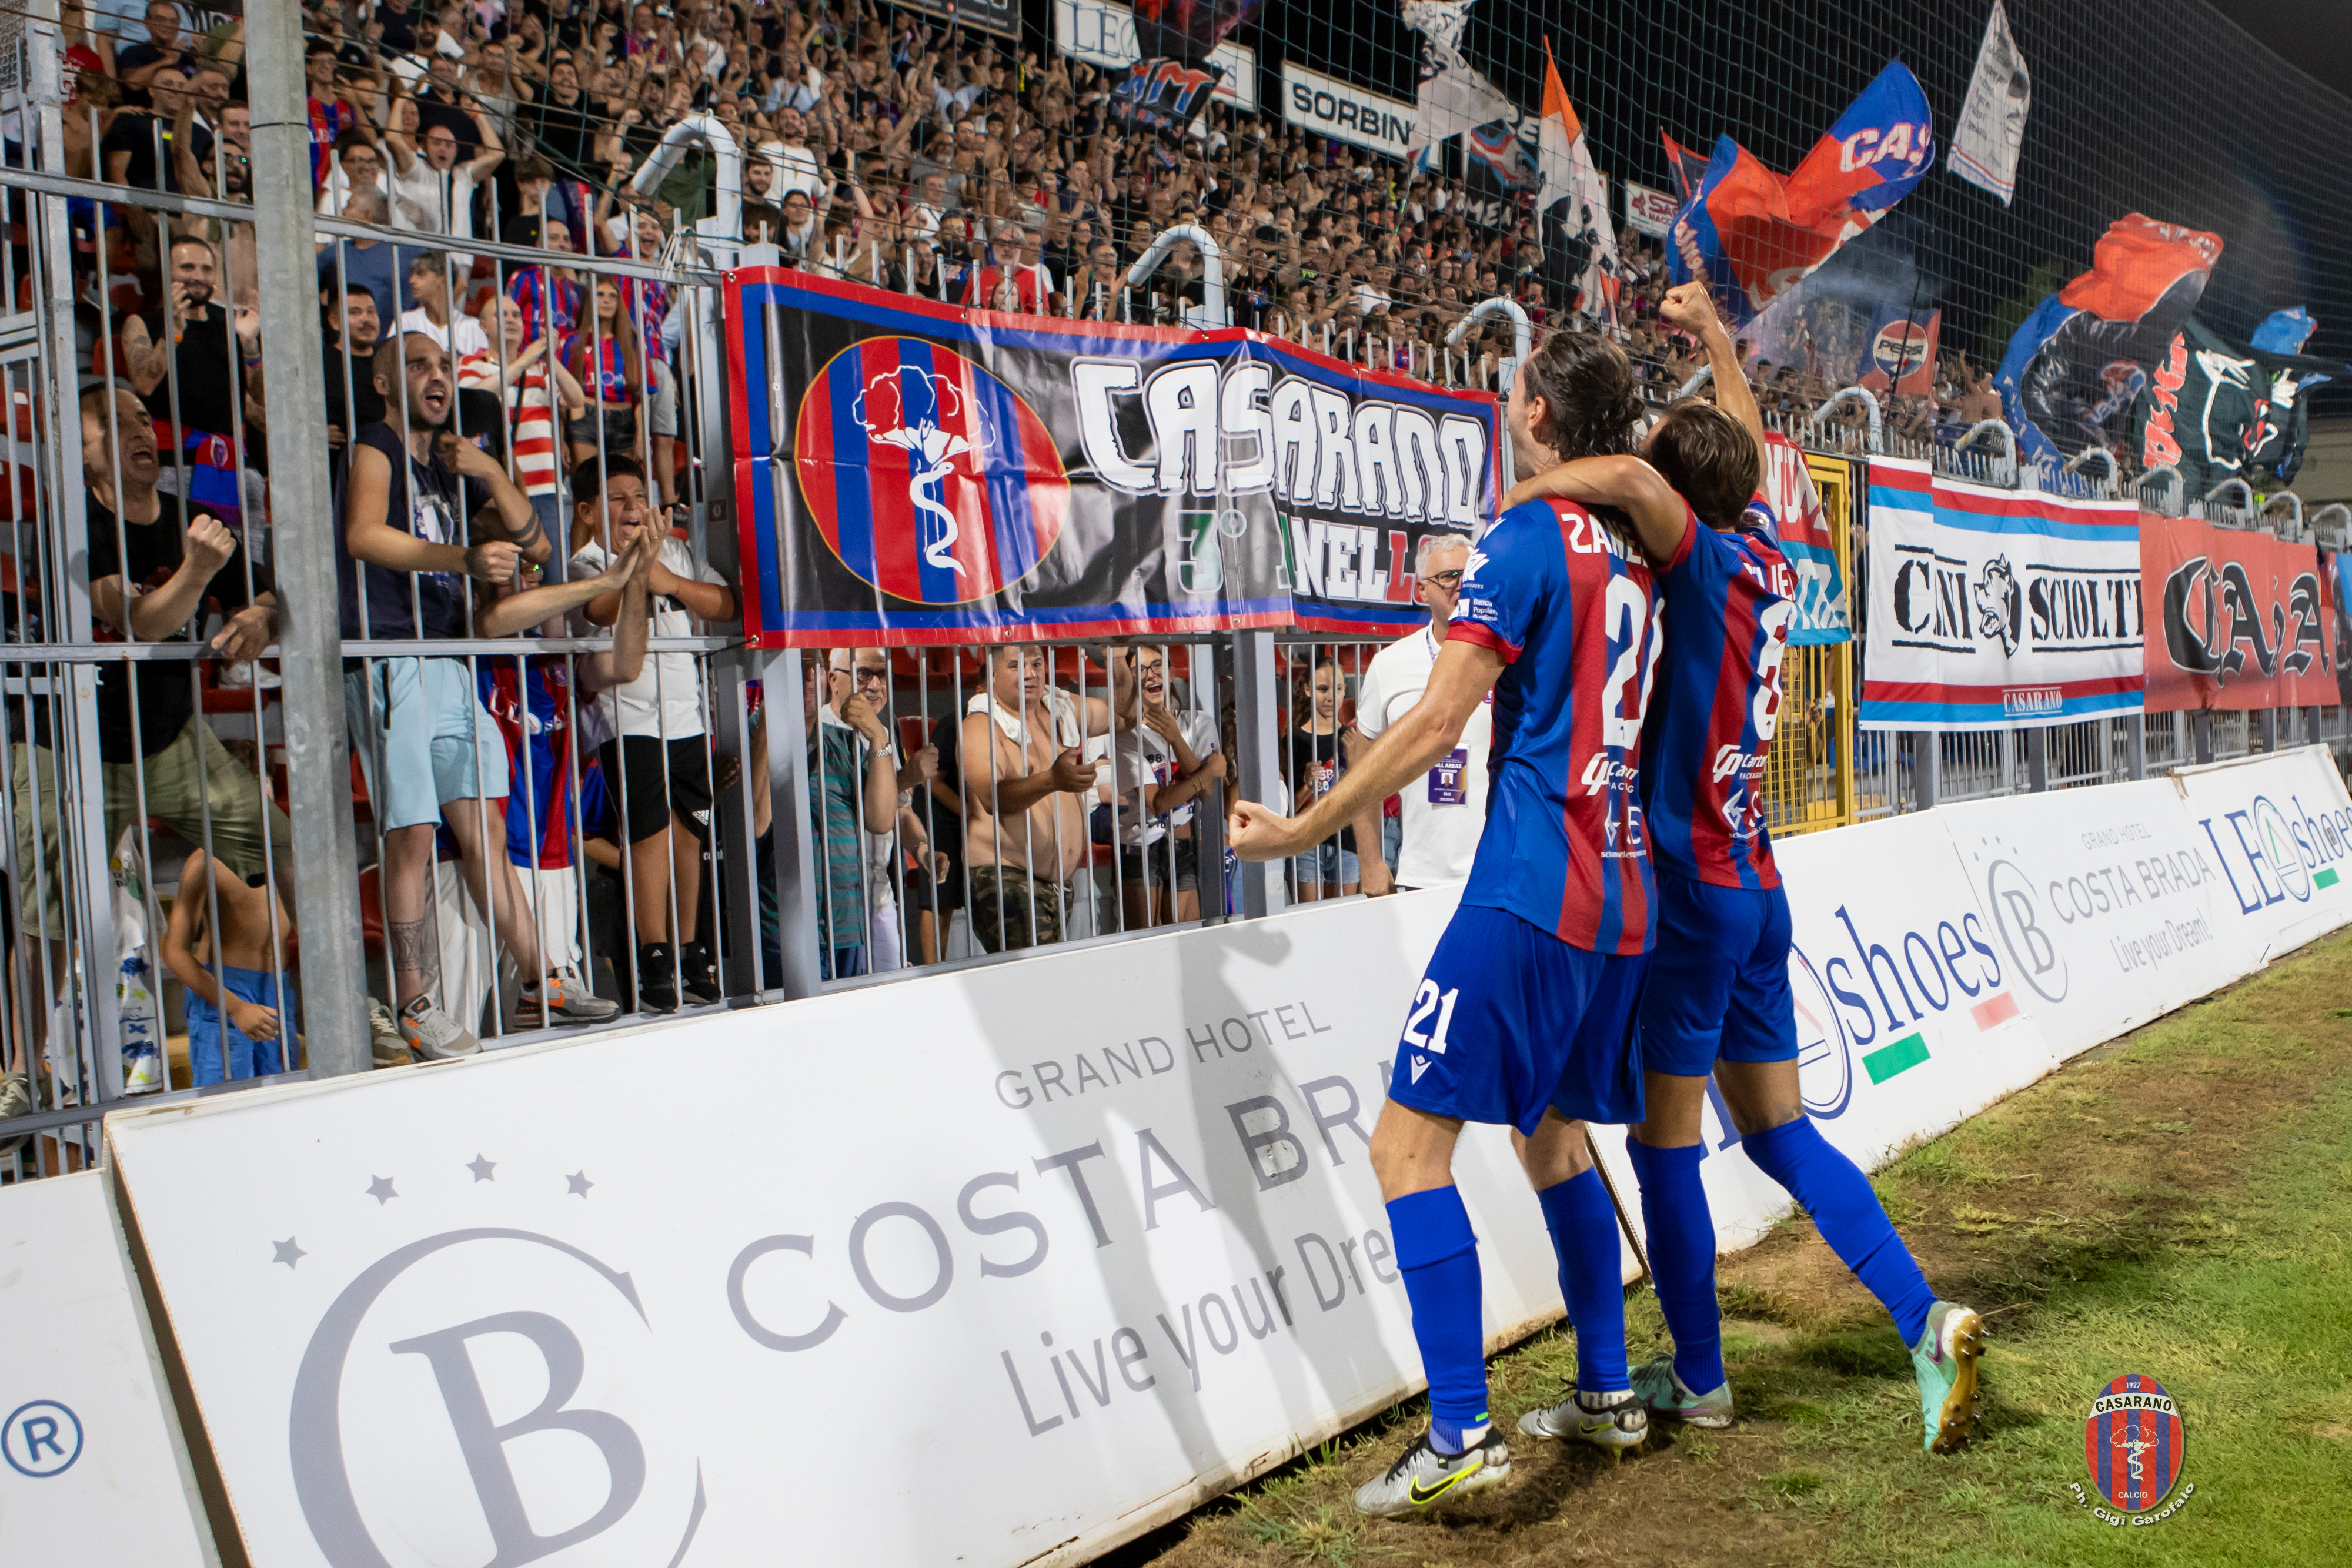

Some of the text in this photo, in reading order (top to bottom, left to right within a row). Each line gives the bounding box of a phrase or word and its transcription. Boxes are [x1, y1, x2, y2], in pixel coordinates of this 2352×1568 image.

[1293, 82, 1410, 145] SORBIN
[1069, 356, 1486, 530] CASARANO
[1473, 599, 1492, 607] Banca
[1894, 559, 2143, 641] CNI SCIOLTI
[2003, 690, 2062, 713] CASARANO
[2082, 823, 2151, 850] GRAND HOTEL
[2049, 847, 2217, 924] COSTA BRADA
[2110, 908, 2213, 973] Live your Dream!
[1403, 978, 1459, 1055] 21
[995, 1001, 1332, 1110] GRAND HOTEL
[727, 1058, 1398, 1353] COSTA BR
[1000, 1222, 1401, 1437] Live your Dre
